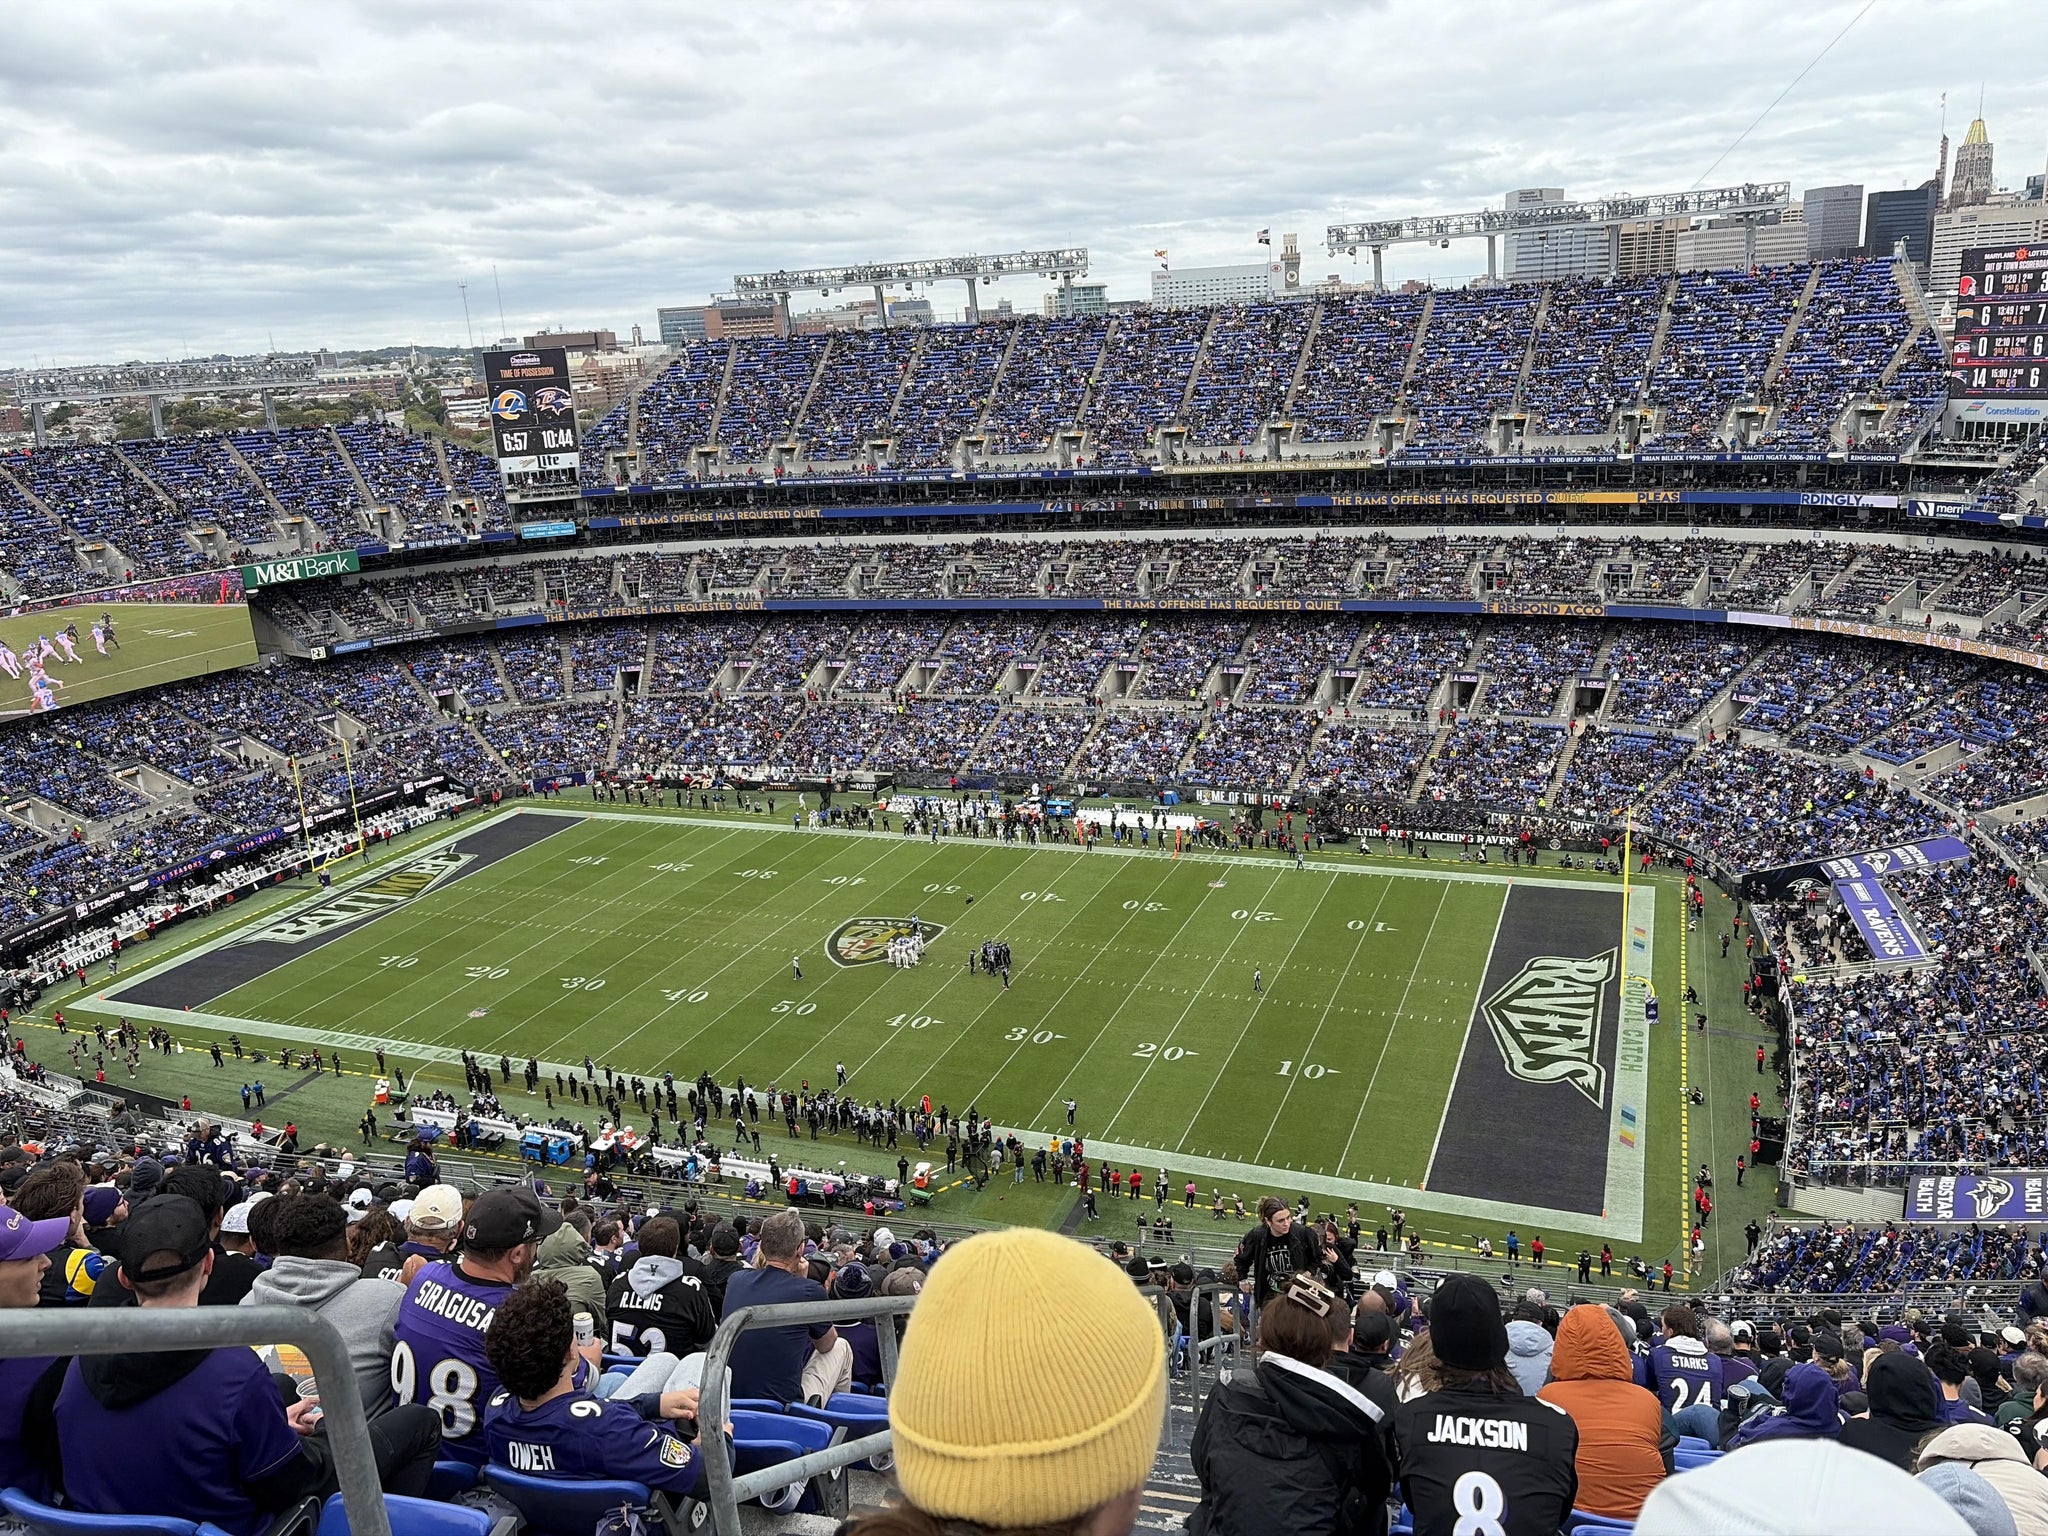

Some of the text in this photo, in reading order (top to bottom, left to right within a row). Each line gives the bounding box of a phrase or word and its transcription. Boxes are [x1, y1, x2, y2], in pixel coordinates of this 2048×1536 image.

[1984, 252, 2016, 260] MARYLAND
[1985, 261, 2018, 271] OUT OF TOWN
[1984, 271, 2048, 294] 0 11:20 3
[1981, 306, 1991, 326] 6
[2038, 304, 2046, 325] 7
[1978, 337, 1988, 357] 0
[2034, 335, 2043, 356] 6
[500, 366, 554, 378] TIME OF POSSESSION
[1972, 368, 2040, 388] 14 15:00 6
[1986, 406, 2040, 416] Constellation
[502, 428, 574, 452] 6:57 10:44
[536, 455, 560, 469] Lite
[1158, 500, 1170, 510] BALL
[1193, 500, 1208, 509] 11:19
[1332, 492, 1680, 506] THE RAMS OFFENSE HAS REQUESTED QUIET. PLEAS
[619, 508, 824, 526] THE RAMS OFFENSE HAS REQUESTED QUIET.
[254, 554, 351, 585] M&T Bank
[544, 601, 766, 622] THE RAMS OFFENSE HAS REQUESTED QUIET.
[1102, 600, 1344, 611] THE RAMS OFFENSE HAS REQUESTED QUIET.
[1498, 603, 1560, 614] RESPOND
[334, 641, 372, 654] PROGRESSIVE
[1790, 616, 1816, 630] THE
[1820, 618, 1860, 634] RAMS
[1864, 625, 1928, 643] OFFENSE
[1930, 634, 1958, 650] HAS
[1961, 640, 2038, 666] REQUESTED
[1228, 791, 1240, 802] OF
[1414, 831, 1520, 846] MARCHING RAVENS
[169, 860, 202, 877] SEASONS
[268, 846, 478, 941] BALTIMORE
[26, 928, 38, 936] WITH
[1861, 907, 1904, 956] RAVENS
[46, 946, 114, 985] BALTIMOR
[378, 956, 419, 969] 10
[466, 966, 510, 980] 20
[562, 976, 606, 991] 30
[664, 988, 709, 1004] 40
[770, 1000, 818, 1016] 50
[885, 1014, 934, 1030] 40
[1487, 954, 1612, 1093] RAVENS
[1620, 976, 1646, 1073] RUCIAL CATCH
[1004, 1026, 1056, 1044] 30
[1132, 1042, 1184, 1061] 20
[1274, 1060, 1326, 1080] 10
[1916, 1178, 1935, 1214] HEALTH
[2024, 1178, 2042, 1214] HEALTH
[414, 1280, 494, 1332] SIRAGUSA
[620, 1291, 664, 1312] R.LEWIS
[1672, 1354, 1708, 1370] STARKS
[391, 1340, 478, 1438] 98
[1671, 1378, 1712, 1415] 24
[1427, 1414, 1528, 1452] JACKSON
[508, 1441, 556, 1471] OWEH
[1453, 1471, 1506, 1536] 8
